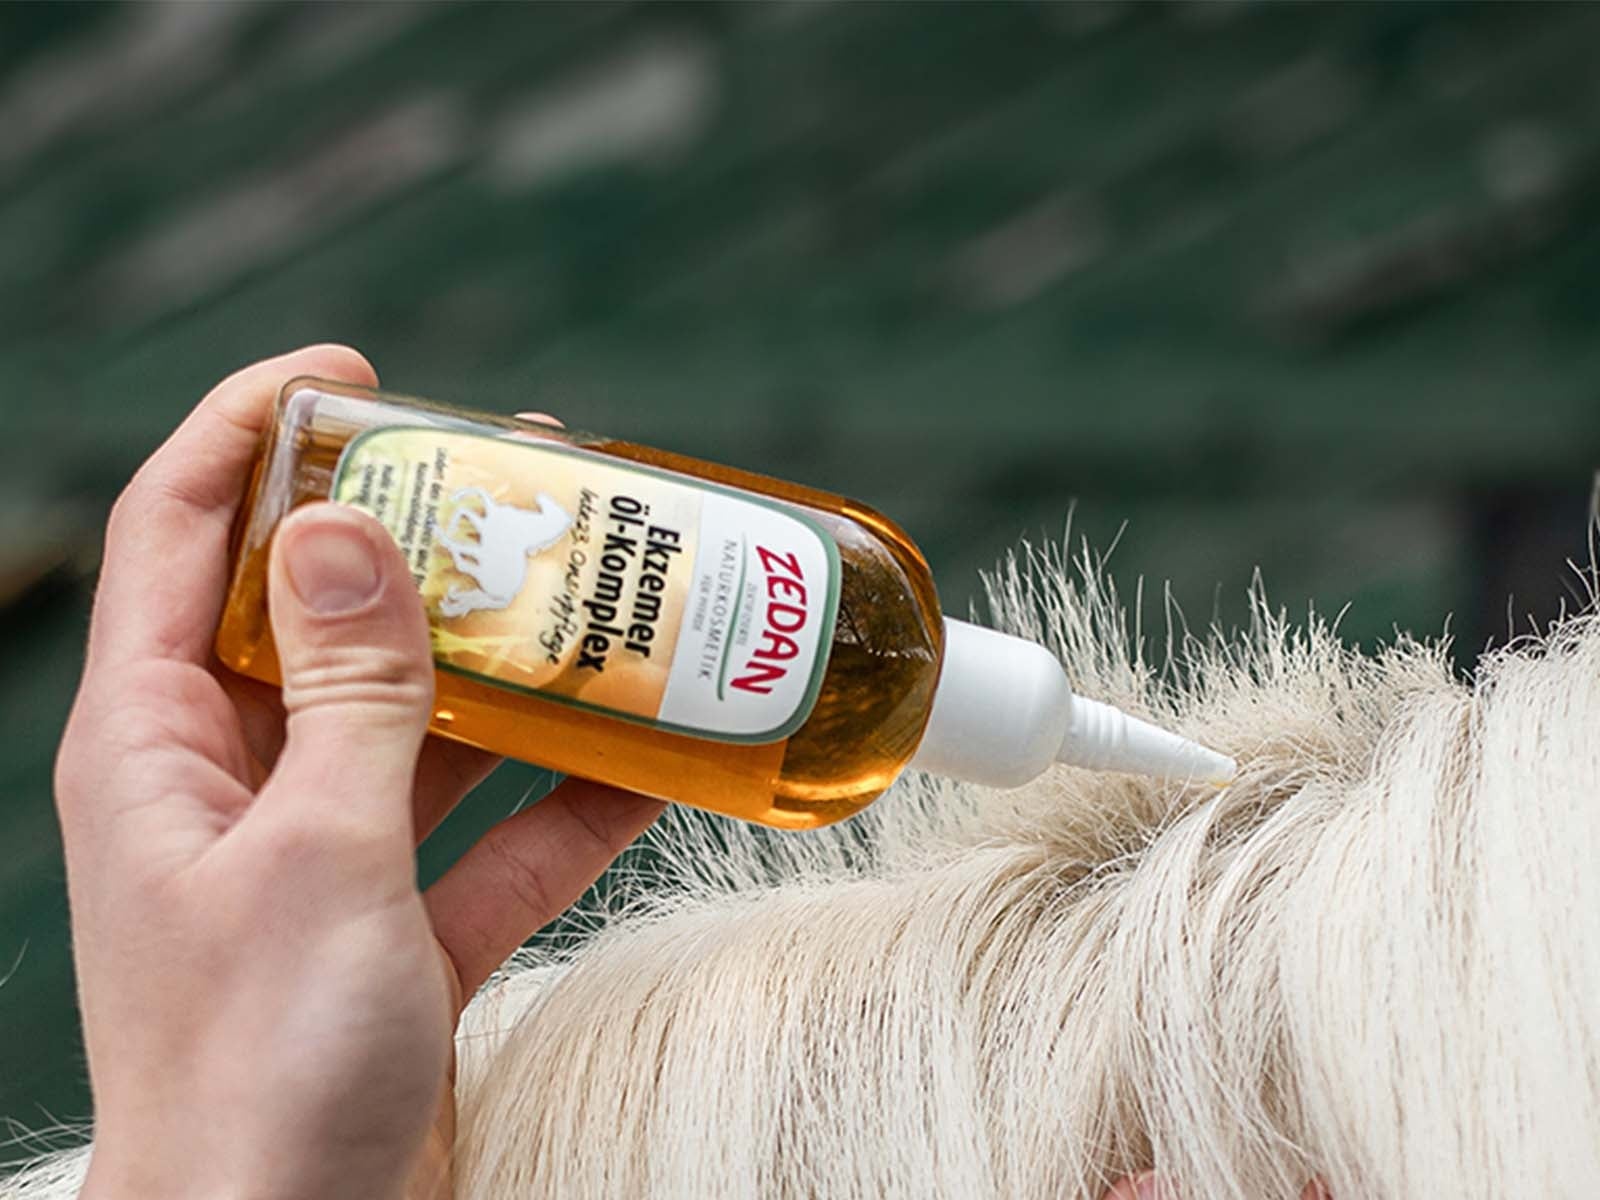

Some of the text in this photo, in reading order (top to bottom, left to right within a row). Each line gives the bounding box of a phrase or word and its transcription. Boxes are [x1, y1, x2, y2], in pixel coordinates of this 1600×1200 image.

[576, 496, 650, 672] Öl-Komplex
[624, 525, 682, 659] Ekzemer
[698, 539, 737, 680] NATURKOSMETIK
[730, 545, 807, 694] ZEDAN
